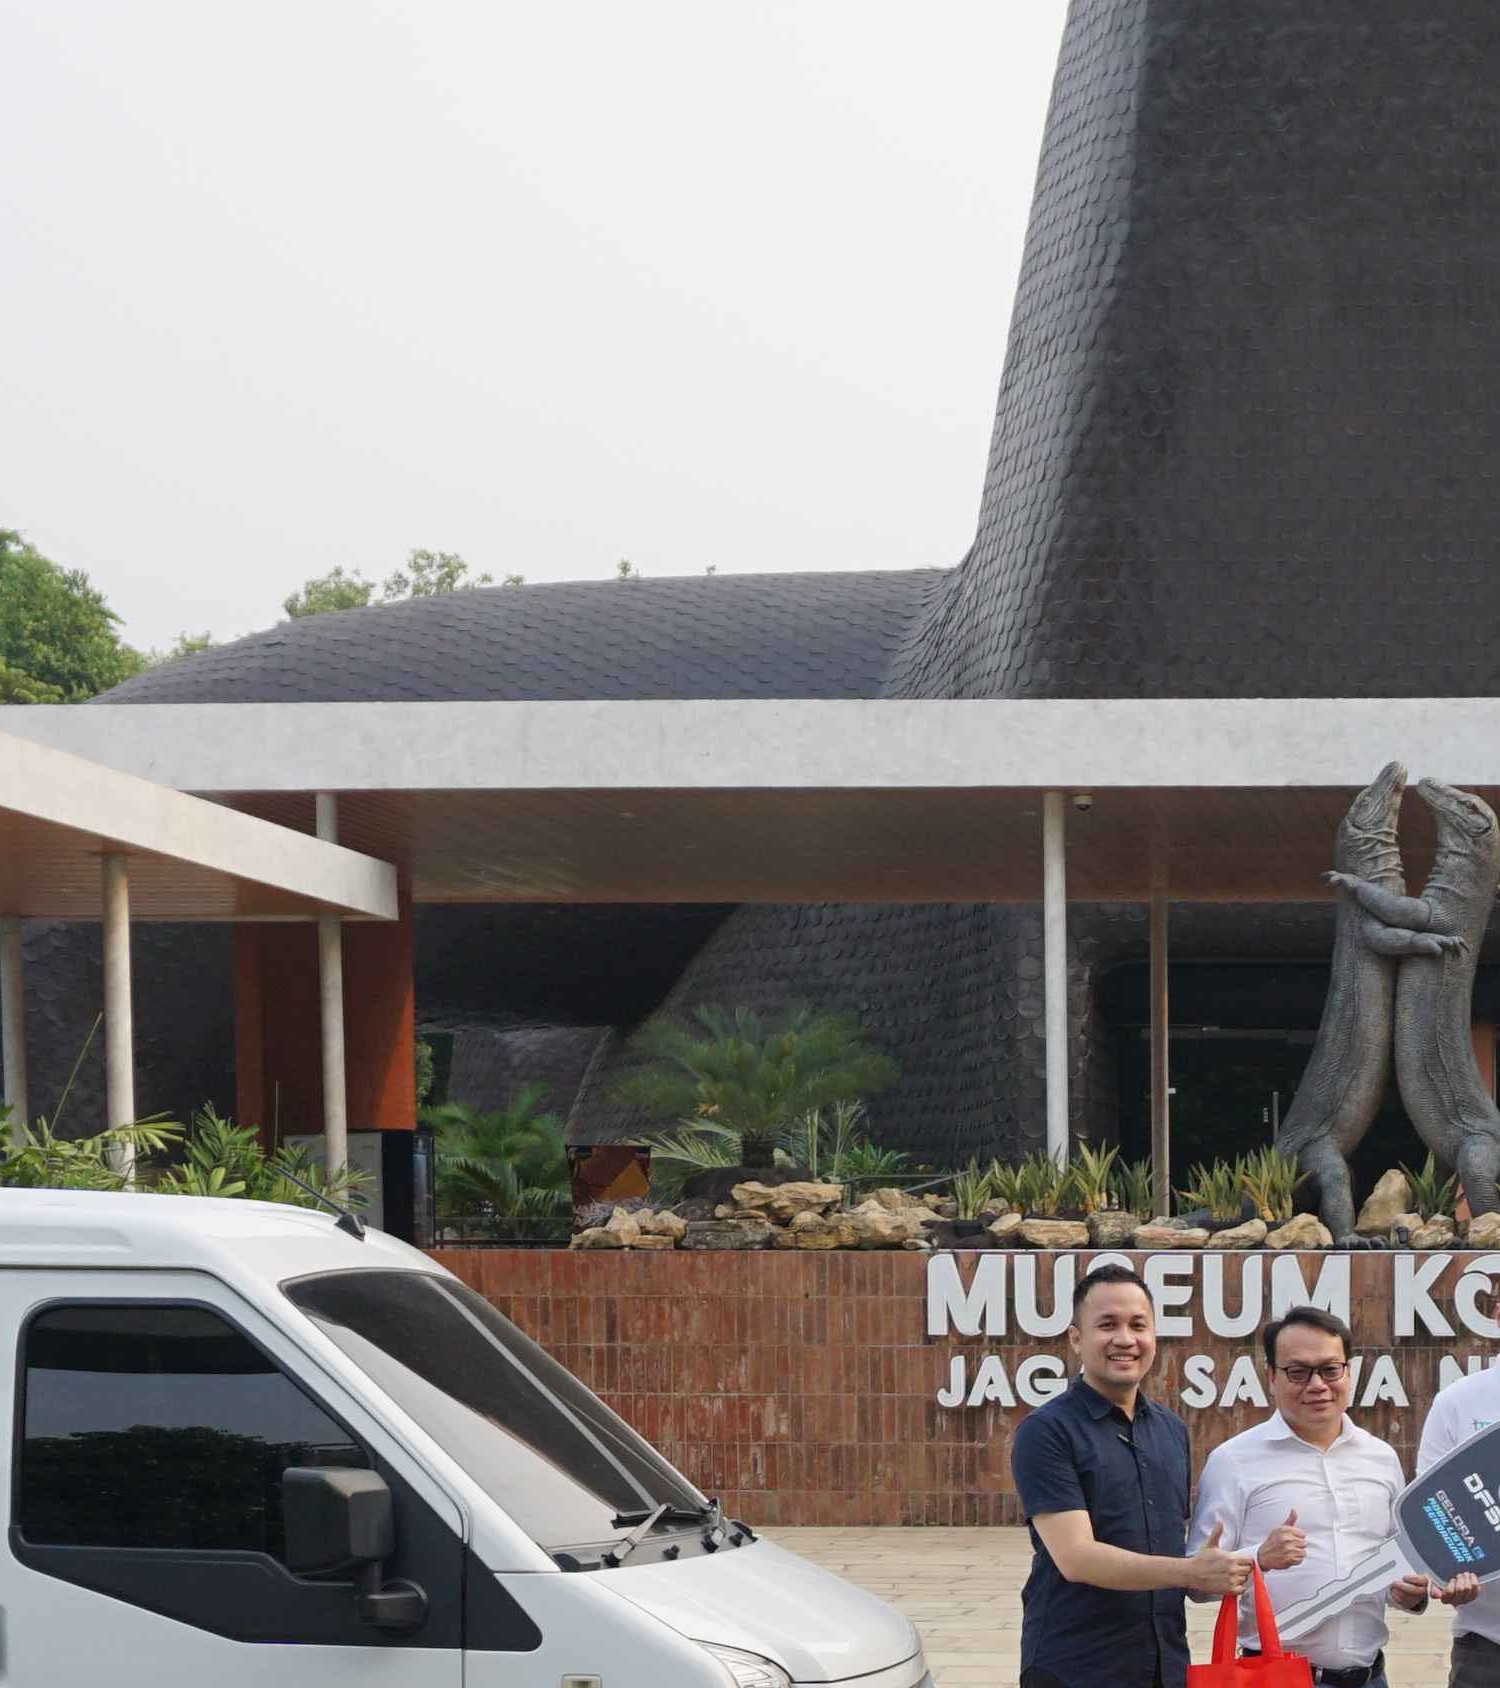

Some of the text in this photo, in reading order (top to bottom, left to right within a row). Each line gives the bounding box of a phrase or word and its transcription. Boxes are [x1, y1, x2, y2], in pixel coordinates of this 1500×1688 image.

[927, 1252, 1350, 1338] MUEUM
[937, 1354, 1084, 1408] JAG
[1180, 1354, 1410, 1409] SAA
[1436, 1490, 1475, 1547] GELORA
